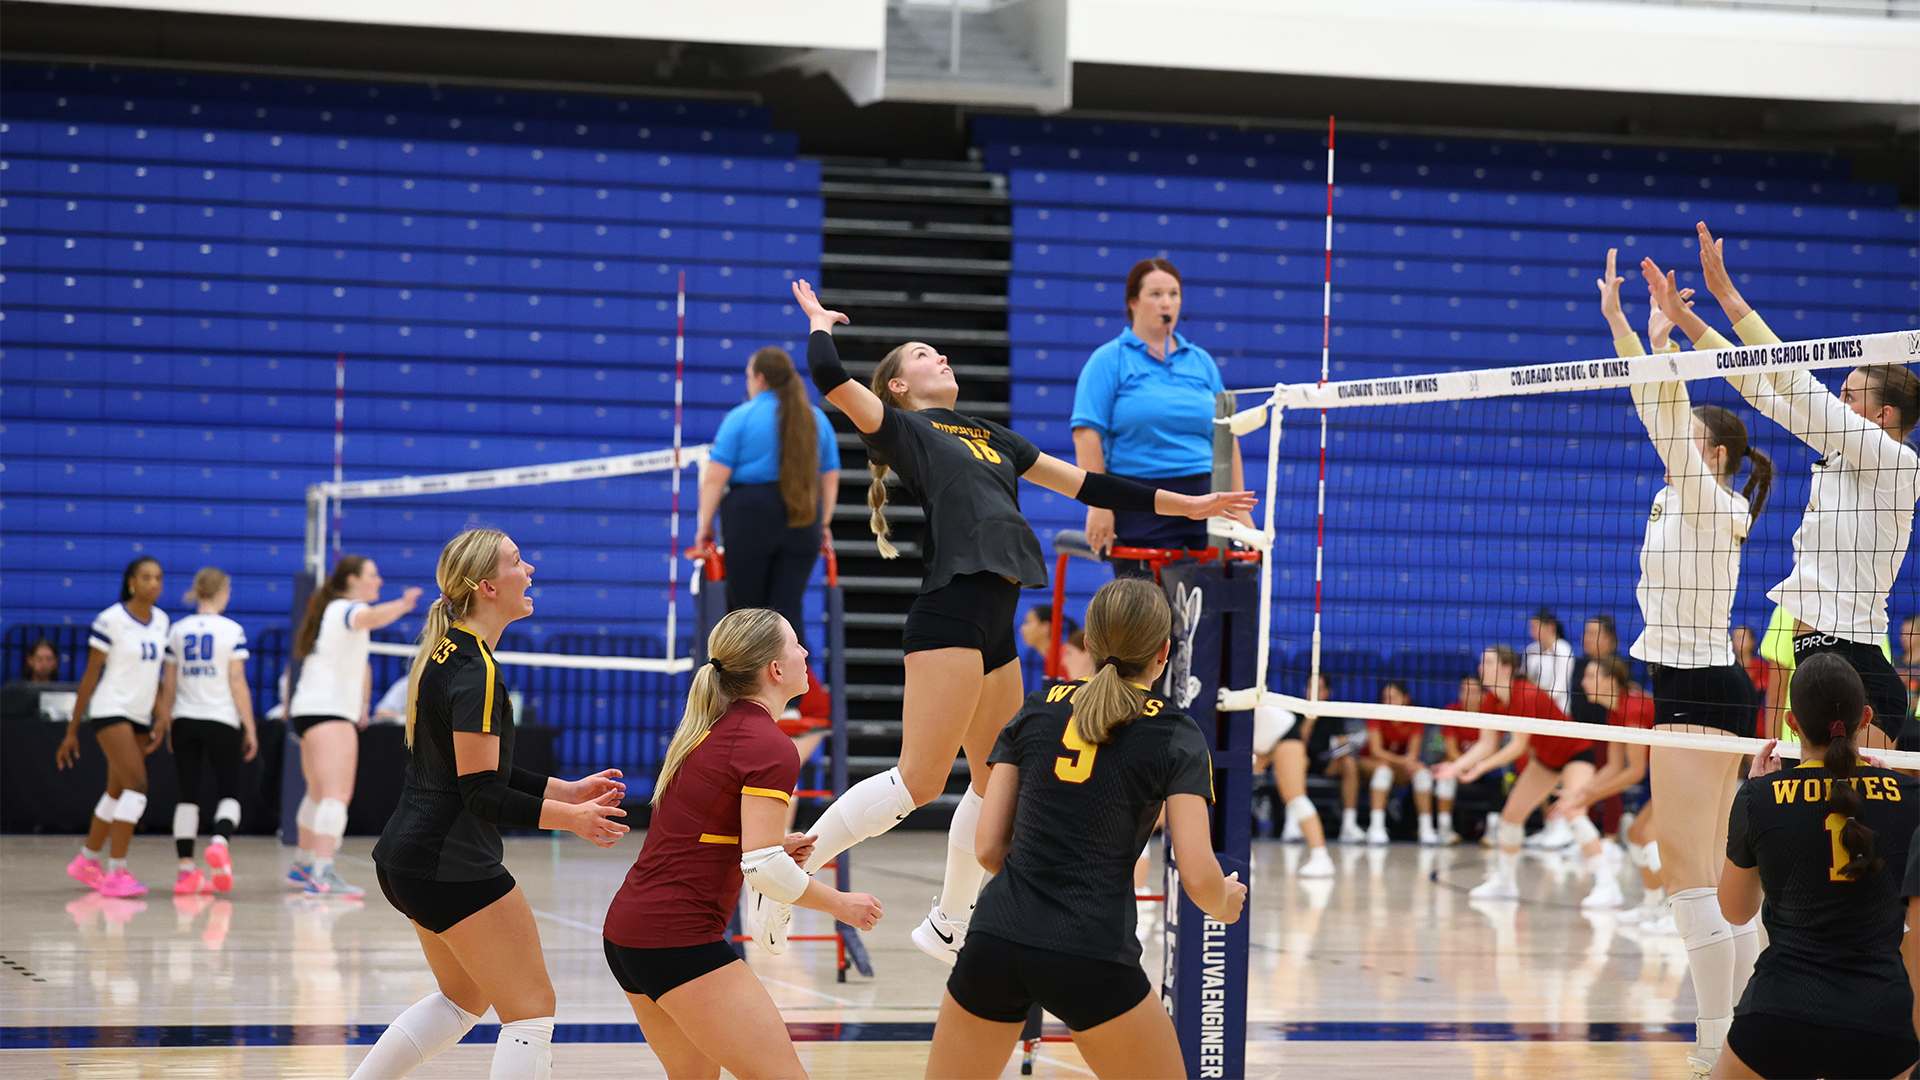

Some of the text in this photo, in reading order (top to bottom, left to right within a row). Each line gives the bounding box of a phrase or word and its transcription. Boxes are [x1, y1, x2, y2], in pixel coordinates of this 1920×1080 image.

[1716, 339, 1863, 369] COLORADO SCHOOL OF MINES
[1510, 360, 1630, 386] COLORADO SCHOOL OF MINES
[1338, 378, 1438, 399] COLORADO SCHOOL OF MINES
[184, 633, 214, 661] 20
[1823, 812, 1857, 882] 1
